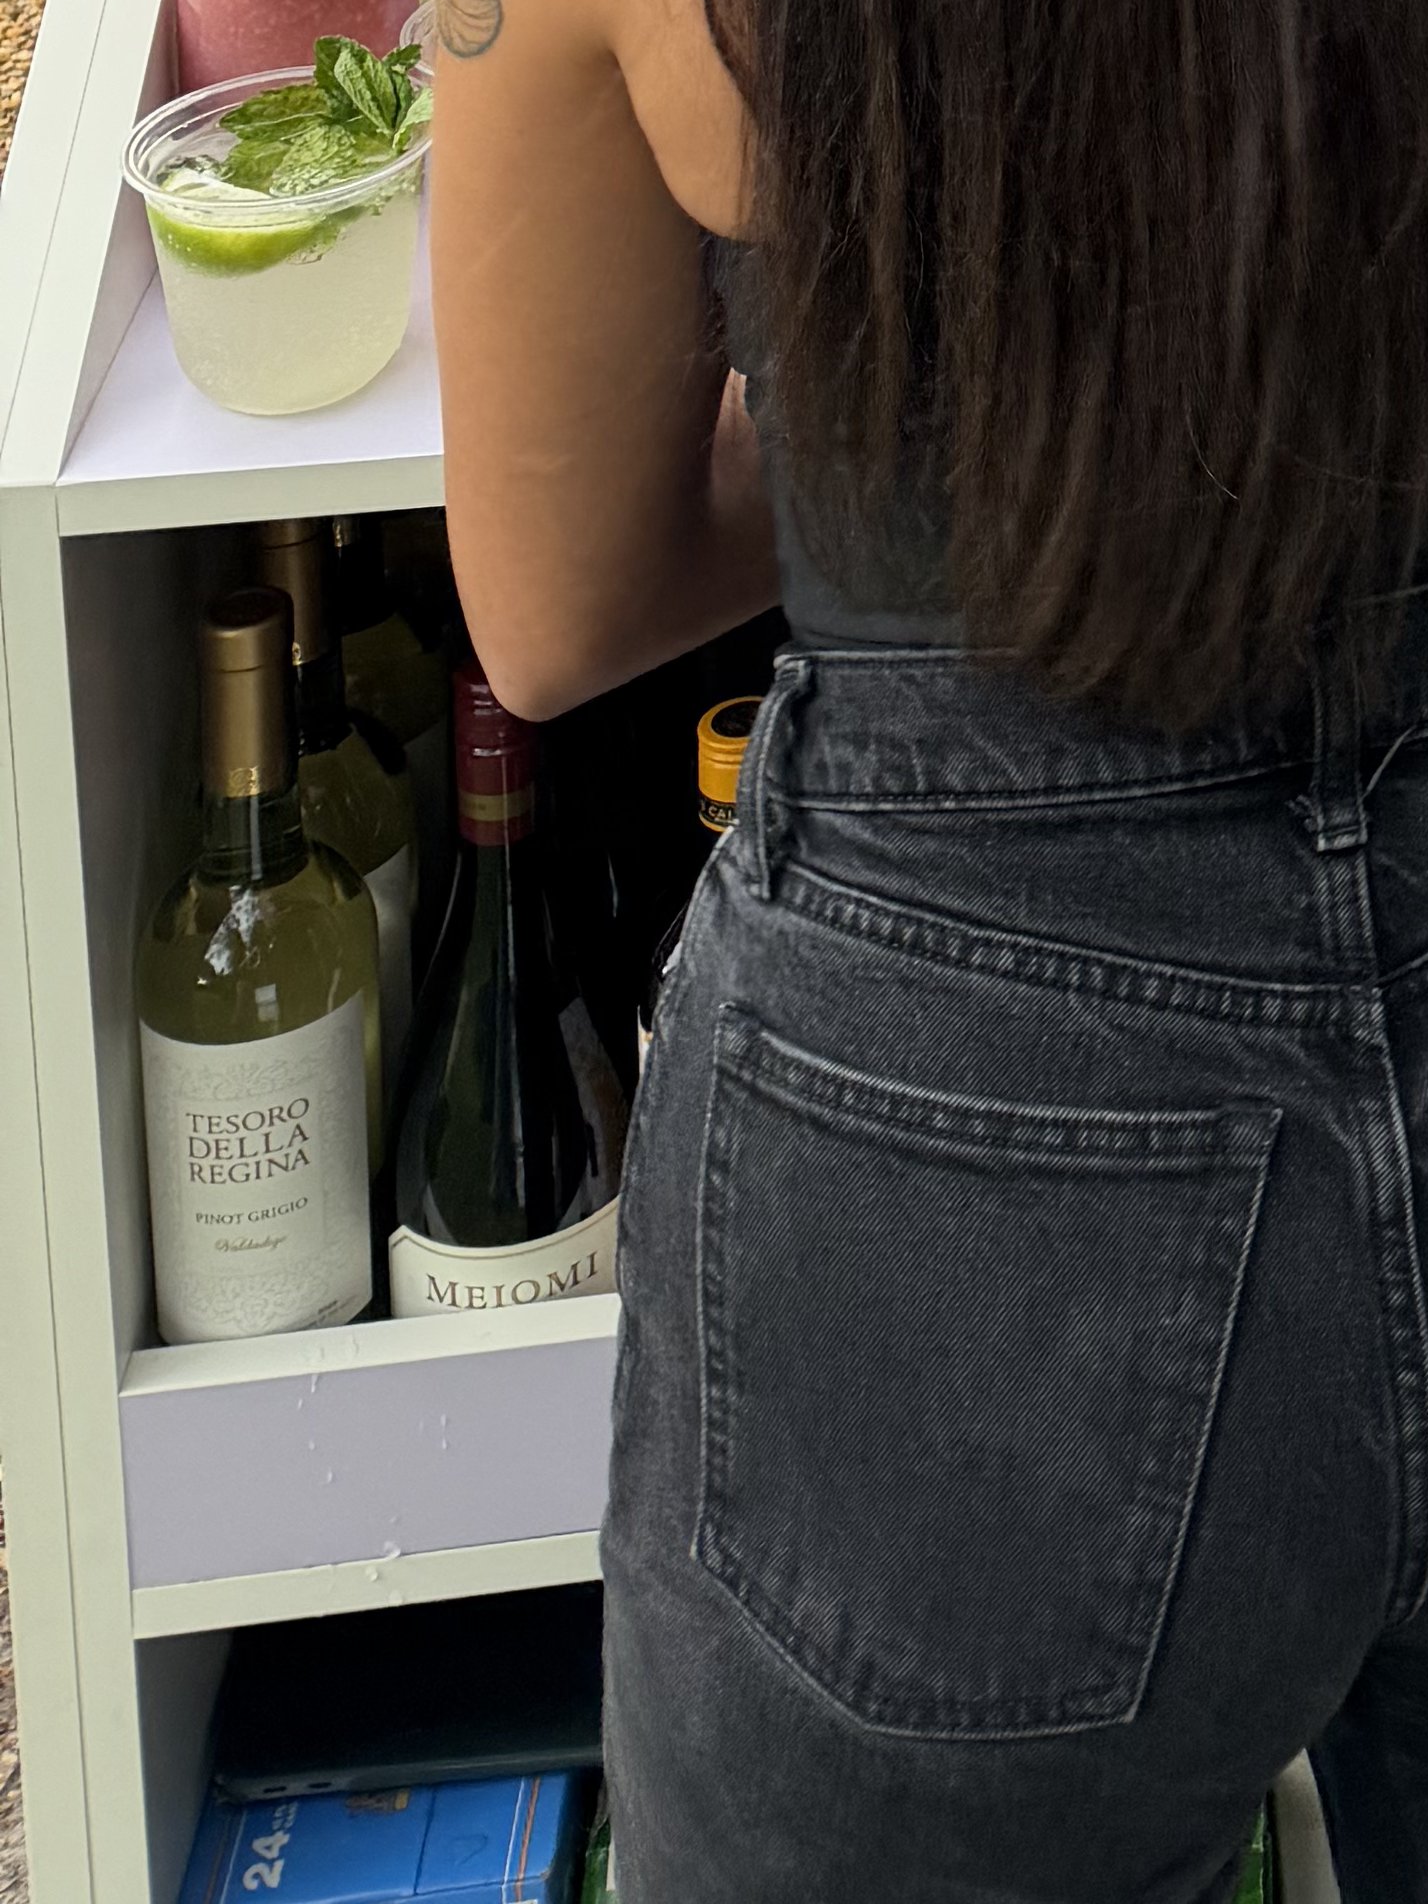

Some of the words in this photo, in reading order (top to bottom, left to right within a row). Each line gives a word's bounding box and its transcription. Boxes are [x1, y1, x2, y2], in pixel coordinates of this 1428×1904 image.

[185, 1097, 310, 1135] TESORO
[188, 1123, 310, 1161] DELLA
[189, 1148, 311, 1185] REGINA
[195, 1212, 244, 1225] PINOT
[247, 1196, 308, 1223] GRIGIO
[426, 1250, 598, 1310] MEIOMI
[241, 1832, 291, 1891] 24
